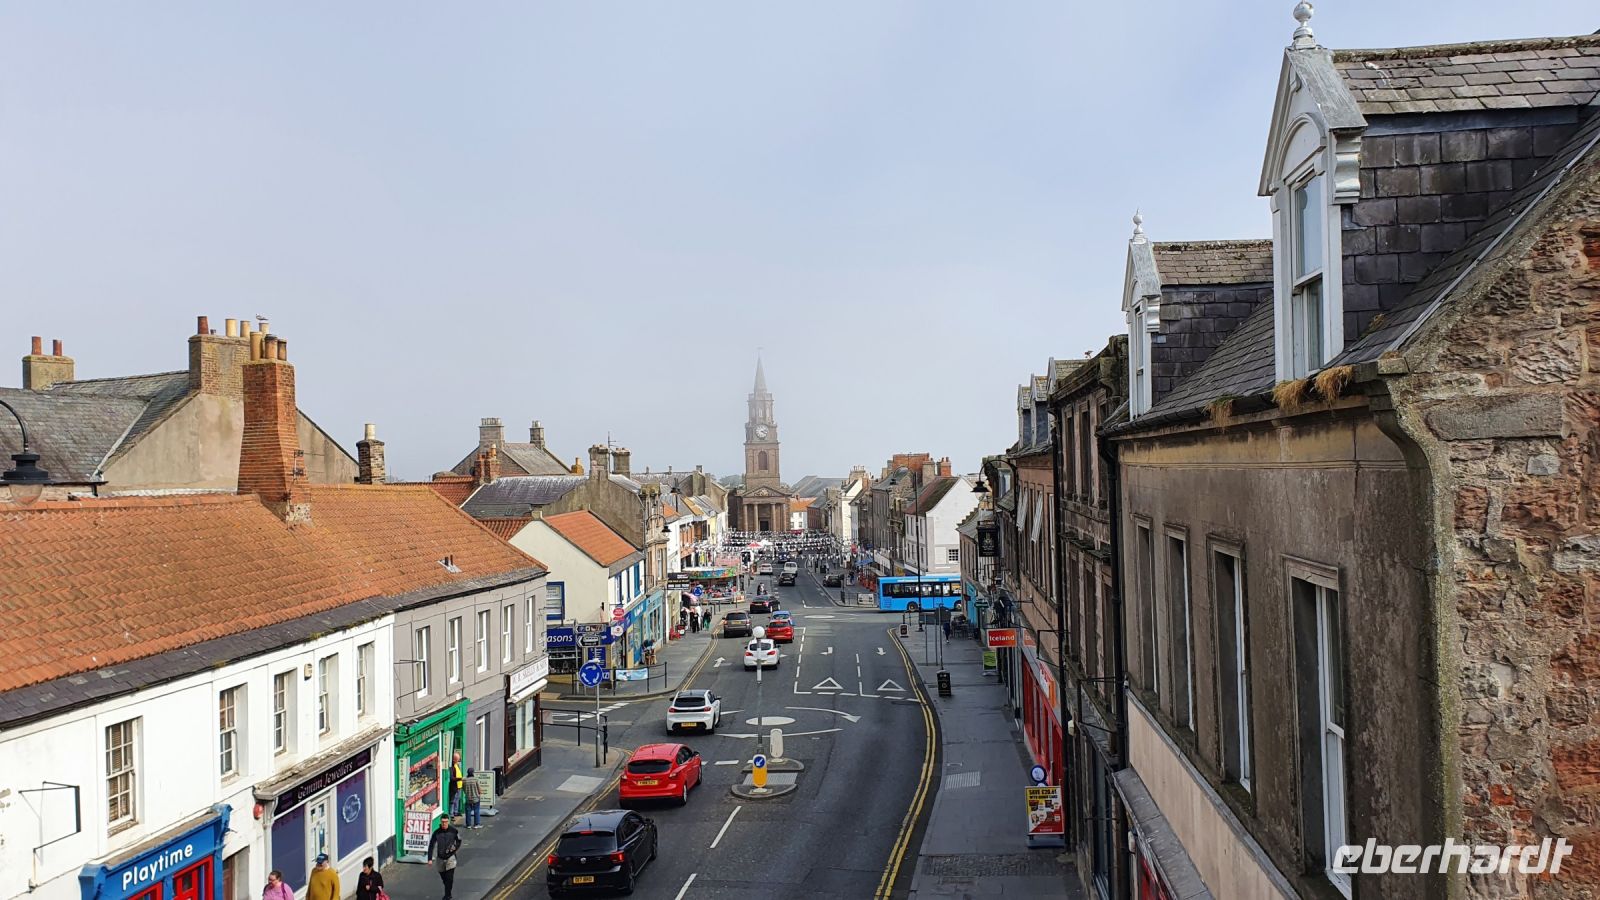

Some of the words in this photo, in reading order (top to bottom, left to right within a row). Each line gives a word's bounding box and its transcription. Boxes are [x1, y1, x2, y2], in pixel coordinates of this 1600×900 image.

[407, 811, 431, 820] MASSIVE
[406, 819, 430, 833] SALE
[122, 844, 193, 891] Playtime
